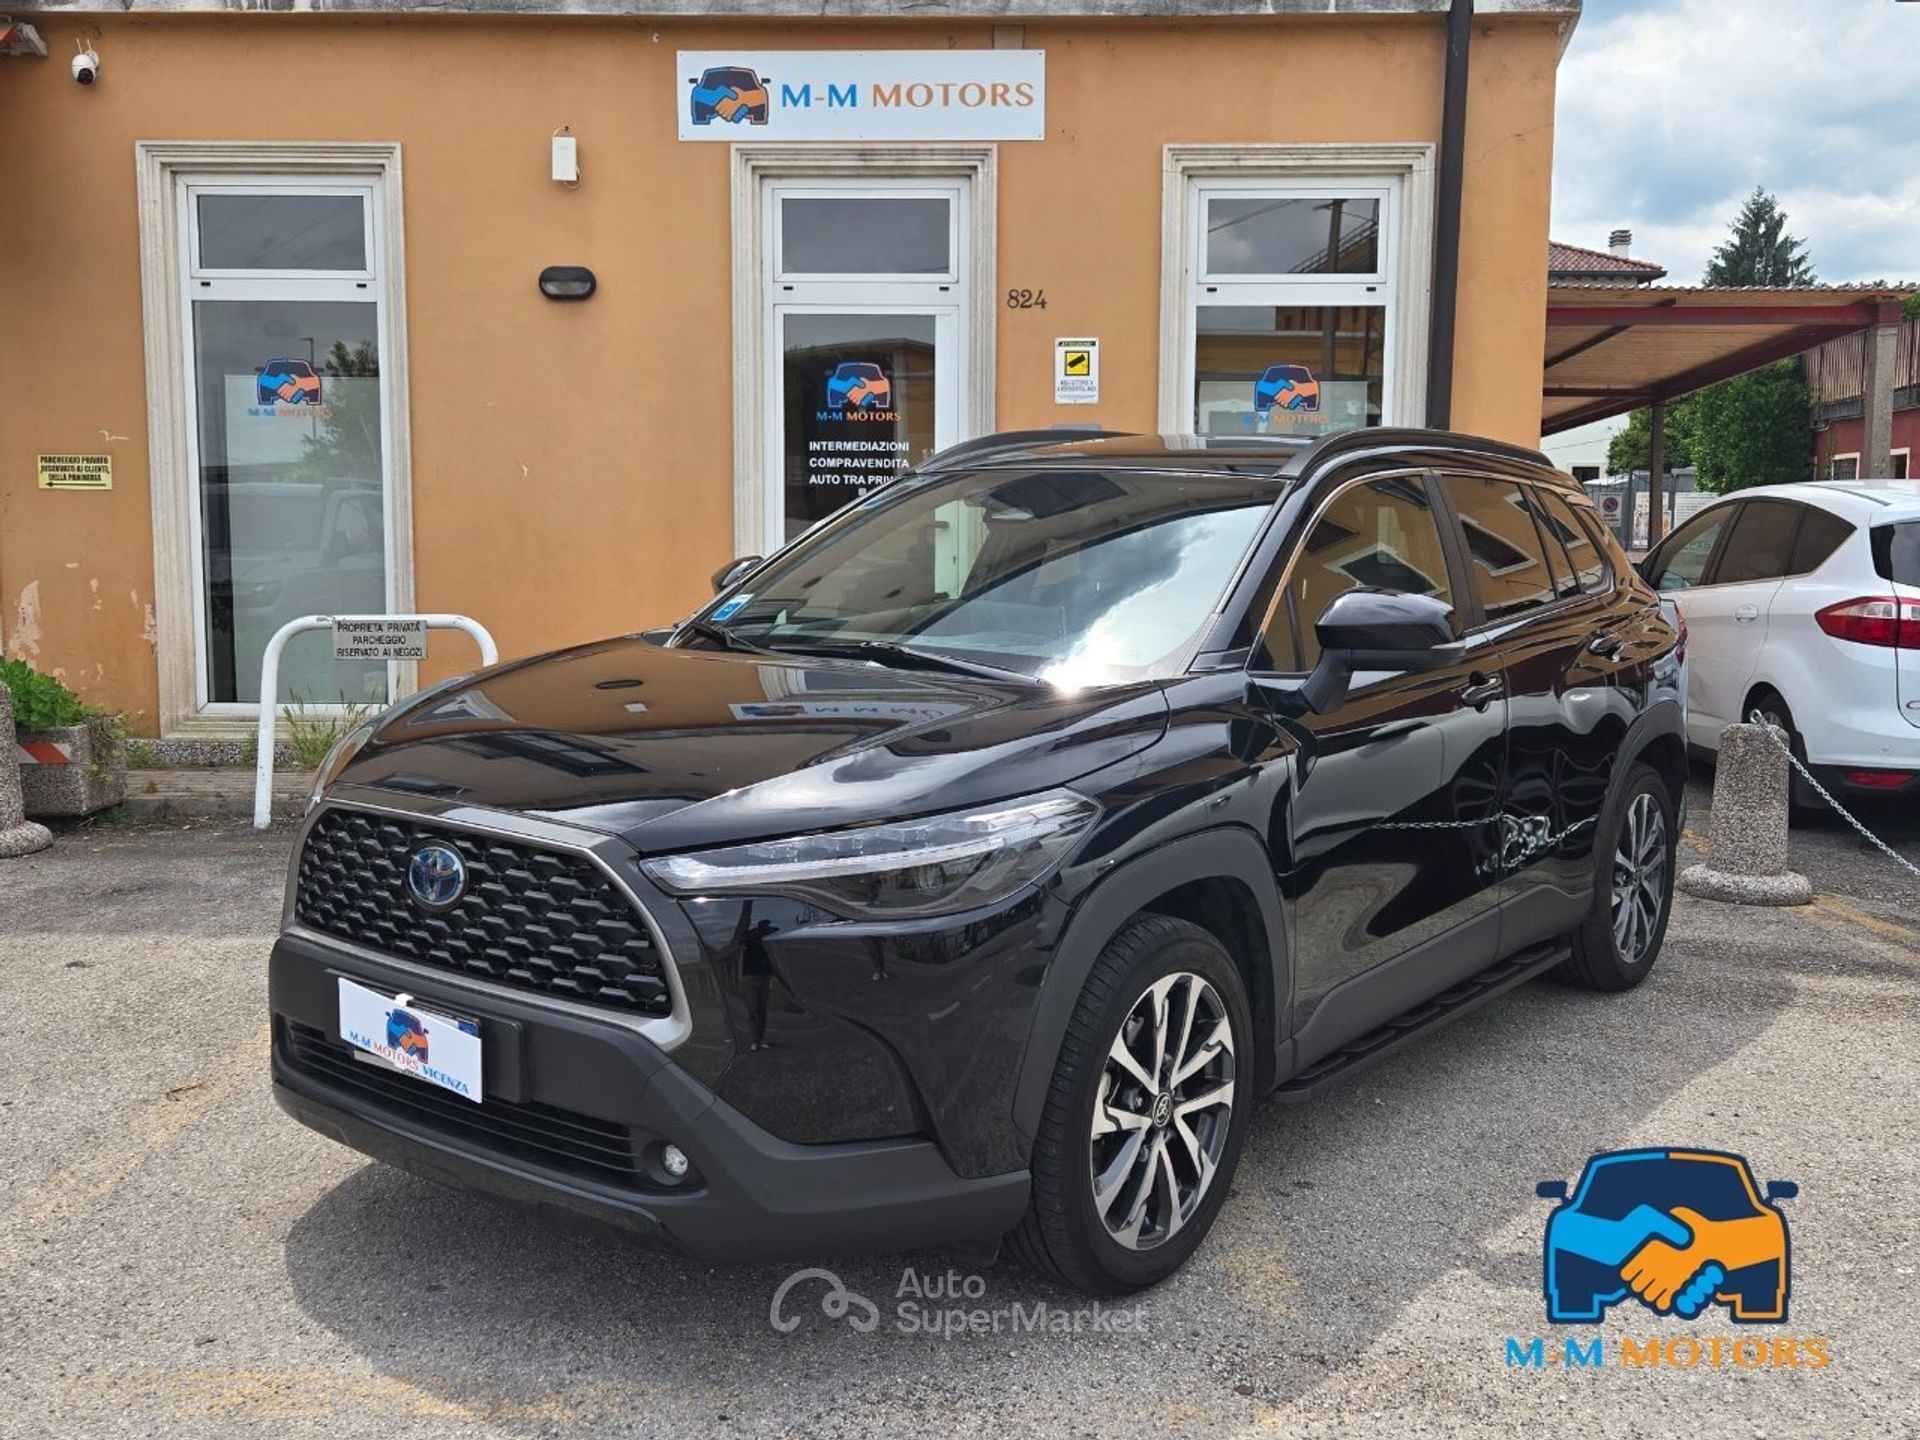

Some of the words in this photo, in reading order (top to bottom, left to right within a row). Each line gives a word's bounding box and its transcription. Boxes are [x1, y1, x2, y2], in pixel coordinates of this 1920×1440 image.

[781, 83, 858, 108] M-M
[872, 82, 1035, 108] MOTORS
[1007, 288, 1047, 309] 824
[816, 411, 843, 422] M-M
[846, 411, 902, 422] MOTORS
[809, 440, 909, 451] INTERMEDIAZIONI
[809, 457, 910, 469] COMPRAVENDITA
[809, 474, 840, 485] AUTO
[843, 475, 866, 485] TRA
[387, 621, 421, 632] PRIVATA
[352, 635, 406, 645] PARCHEGGIO
[336, 647, 379, 657] RISERVATO
[382, 647, 391, 657] AI
[393, 647, 422, 657] NEGOZI
[349, 1029, 371, 1048] M-M
[373, 1041, 418, 1071] MOTORS
[422, 1063, 469, 1095] VICENZA
